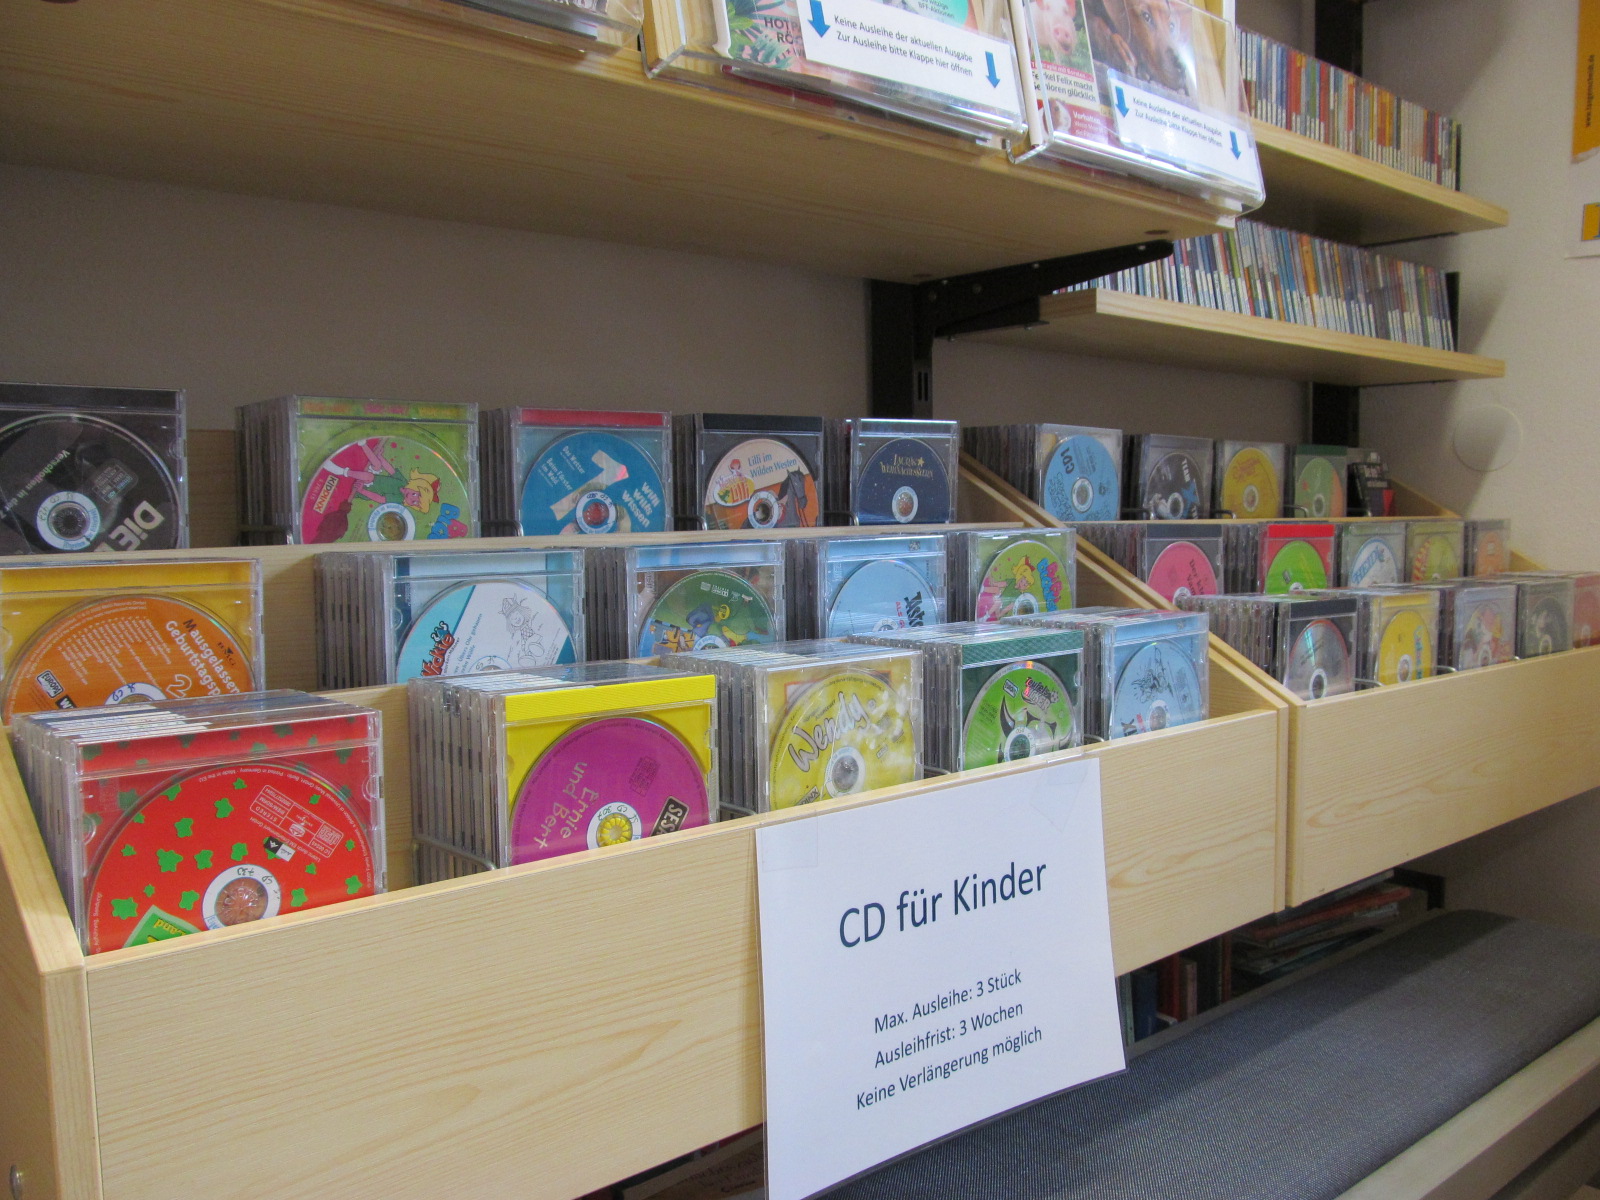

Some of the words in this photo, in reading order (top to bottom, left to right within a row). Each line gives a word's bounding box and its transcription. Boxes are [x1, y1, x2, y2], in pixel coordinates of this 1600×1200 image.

[834, 14, 857, 29] Keine
[859, 22, 893, 38] Ausleihe
[895, 31, 908, 42] der
[910, 35, 943, 53] aktuellen
[944, 46, 973, 63] Ausgabe
[837, 31, 850, 42] Zur
[853, 36, 887, 52] Ausleihe
[889, 45, 907, 57] bitte
[909, 49, 934, 65] Klappe
[936, 58, 949, 69] hier
[950, 63, 973, 77] öffnen
[1057, 75, 1072, 86] Felix
[1073, 81, 1092, 92] macht
[1068, 89, 1096, 103] glücklich
[748, 454, 761, 467] Lilli
[763, 453, 772, 462] im
[750, 465, 773, 478] Wilden
[774, 458, 797, 471] Westen
[314, 476, 338, 513] KIDDINX
[787, 691, 871, 773] Wendy
[562, 761, 588, 798] und
[532, 801, 571, 850] Bert
[559, 786, 598, 840] Ernie
[839, 901, 886, 949] CD
[897, 889, 942, 931] für
[954, 861, 1046, 917] Kinder
[874, 1011, 909, 1034] Max.
[912, 988, 973, 1021] Ausleihe:
[976, 981, 985, 997] 3
[988, 969, 1022, 994] Stück
[874, 1027, 955, 1068] Ausleihfrist:
[959, 1019, 967, 1036] 3
[970, 1002, 1023, 1032] Wochen
[857, 1081, 896, 1110] Keine
[899, 1048, 989, 1092] Verlängerung
[992, 1026, 1042, 1056] möglich
